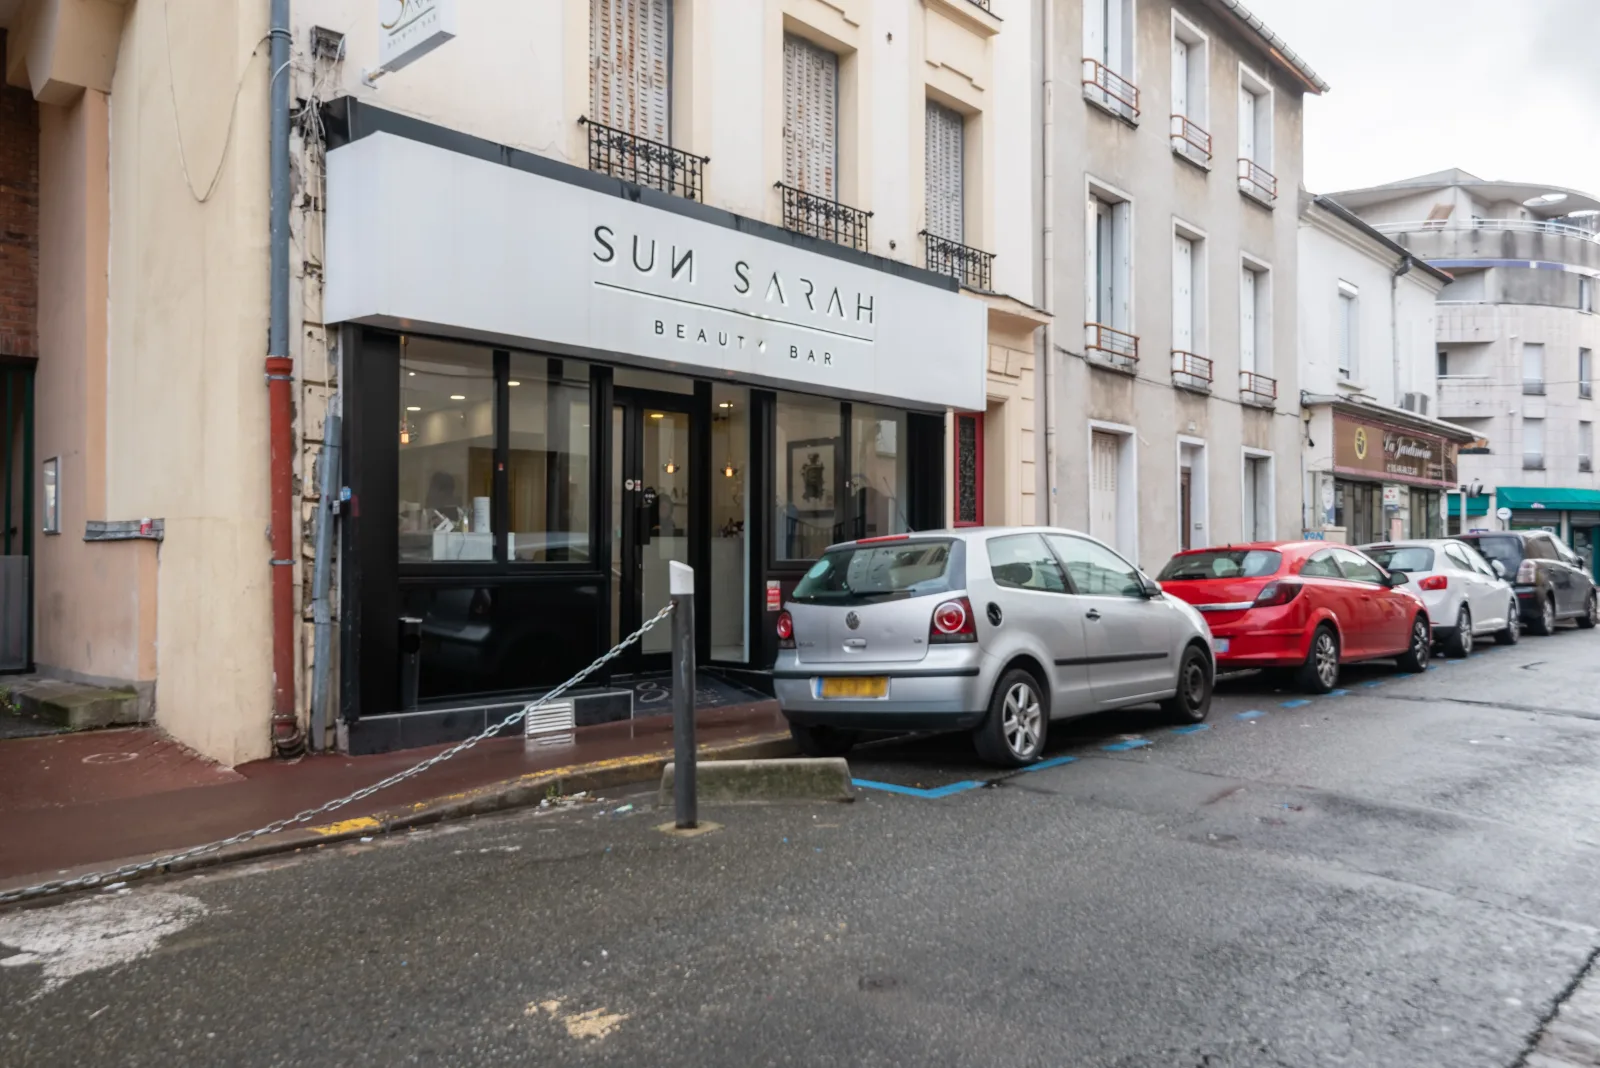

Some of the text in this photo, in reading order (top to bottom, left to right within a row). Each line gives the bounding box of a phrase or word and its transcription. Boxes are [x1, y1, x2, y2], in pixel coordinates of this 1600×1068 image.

[593, 226, 873, 324] SUN SARAH
[655, 320, 833, 365] BEAUT BAR
